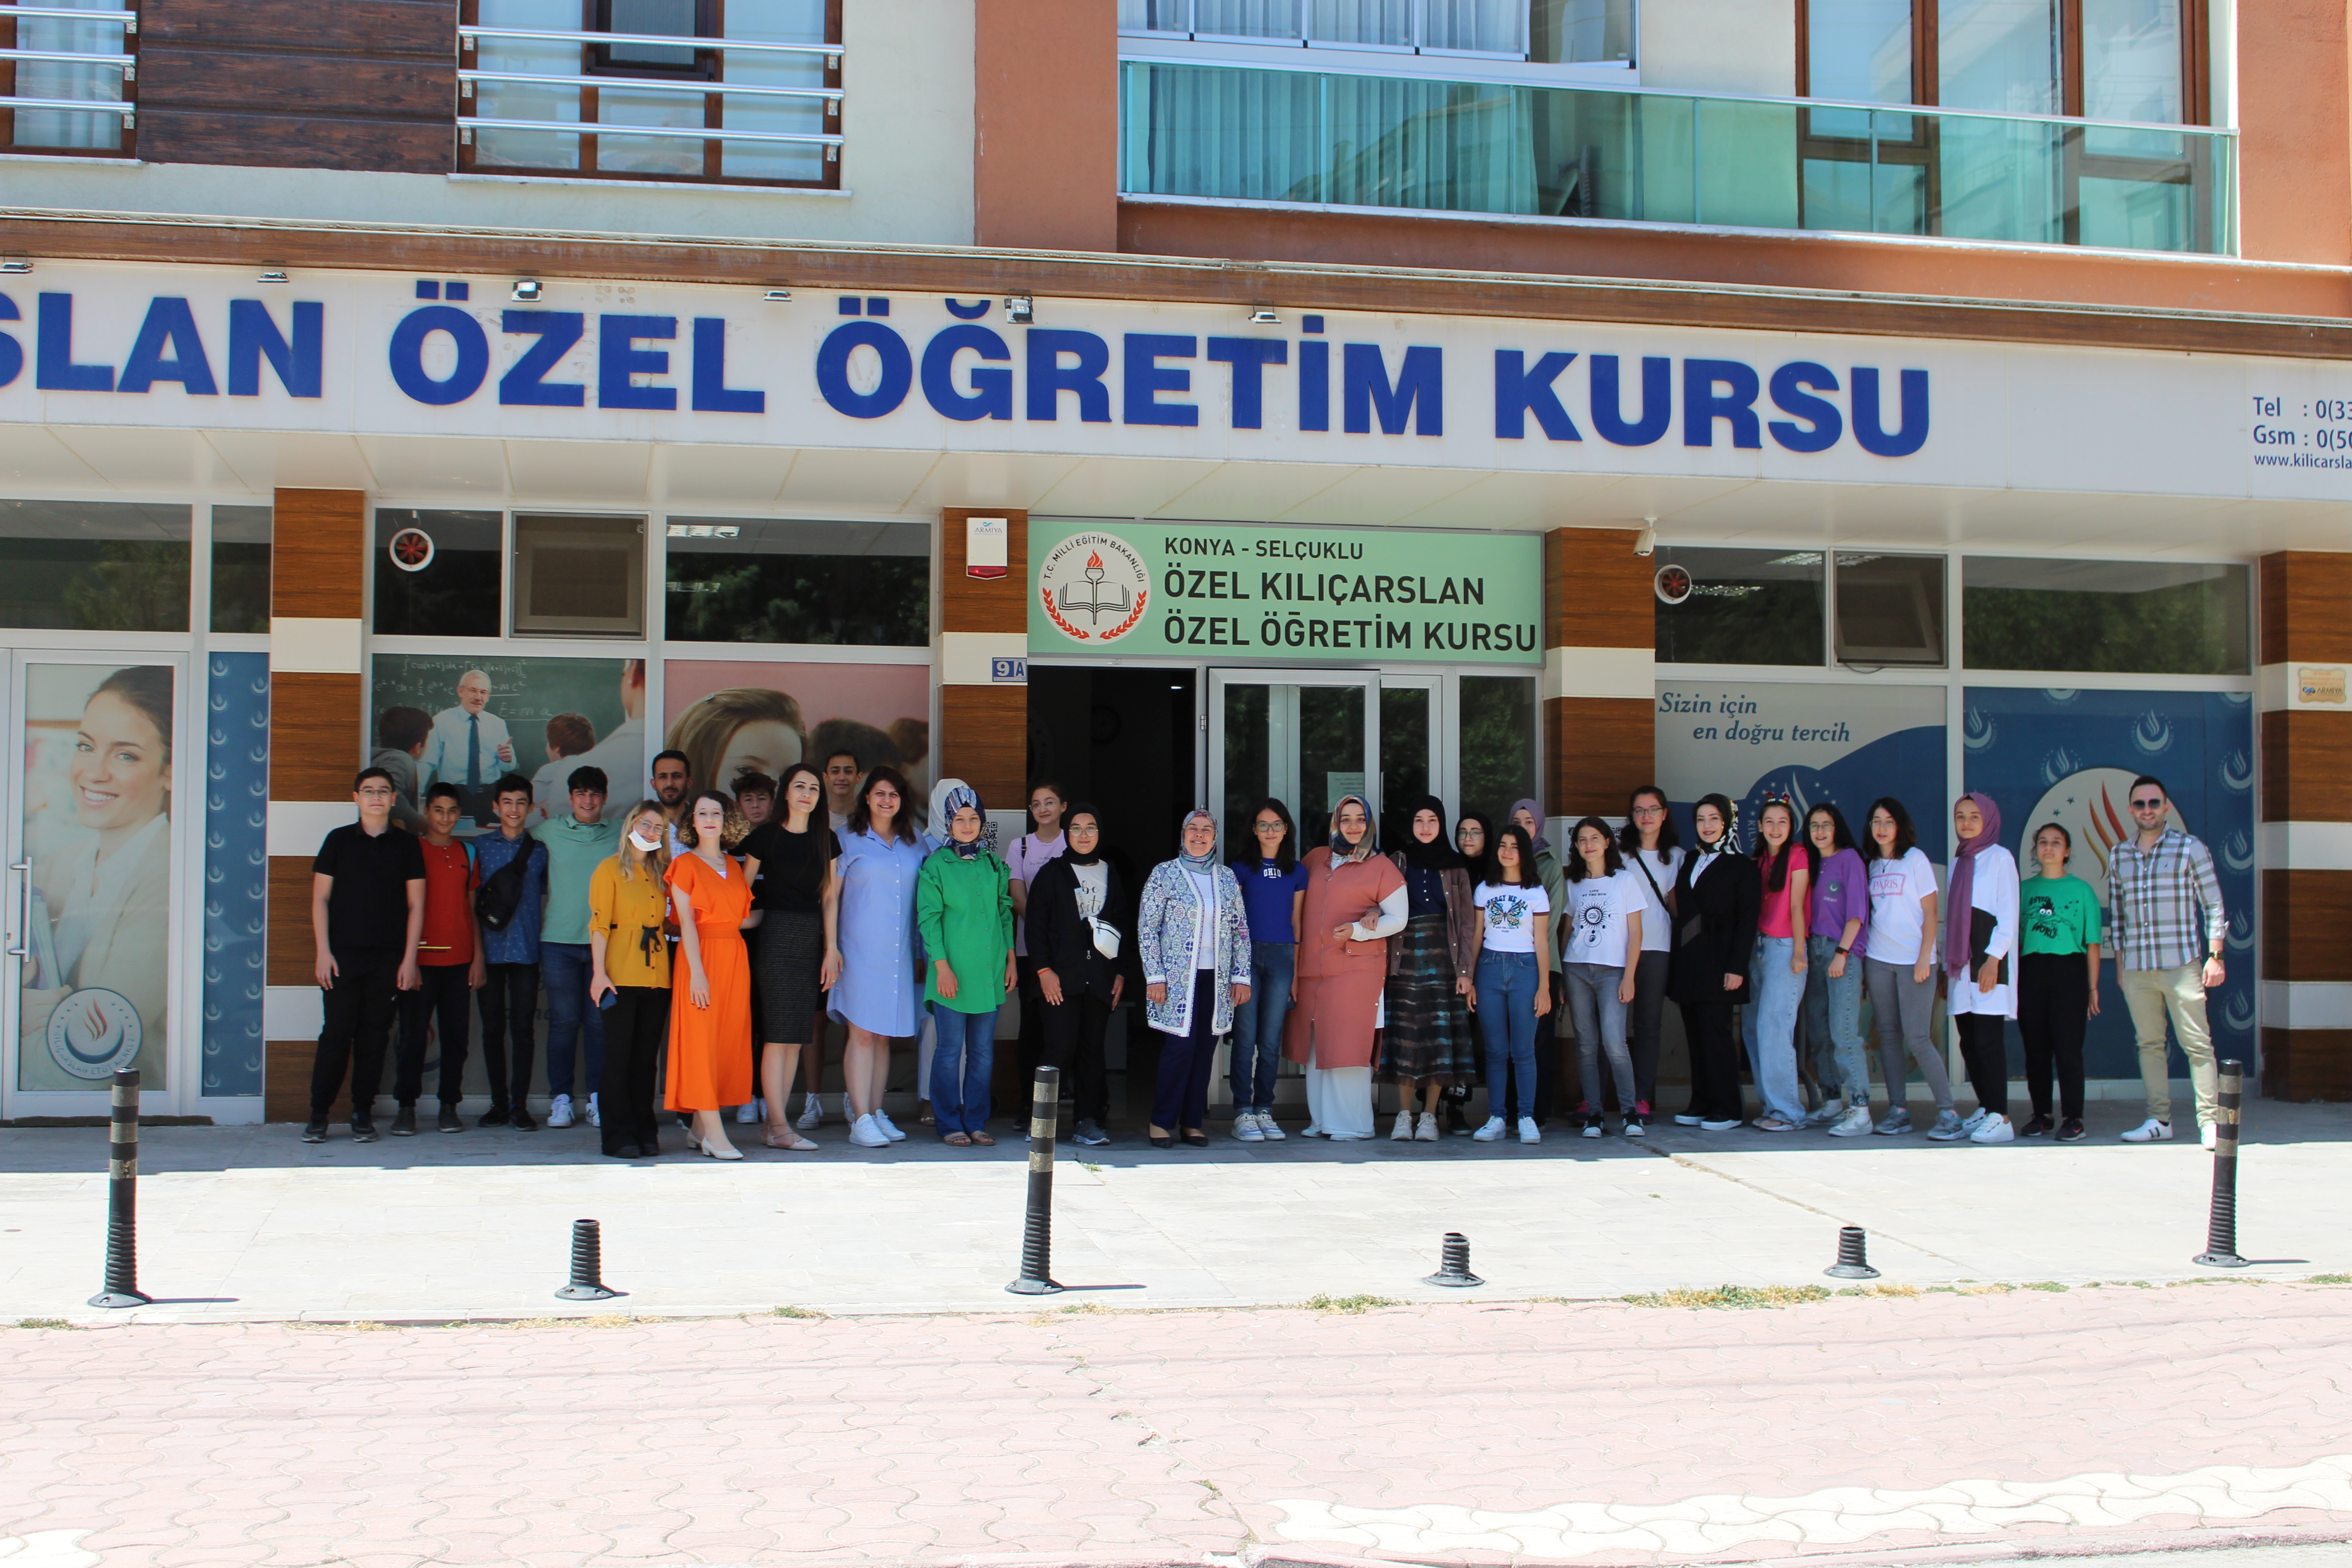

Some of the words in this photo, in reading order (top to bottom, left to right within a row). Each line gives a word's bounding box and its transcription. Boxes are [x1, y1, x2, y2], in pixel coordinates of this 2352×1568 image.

[388, 280, 765, 413] ÖZEL
[816, 297, 1443, 436] ÖĞRETİM
[1495, 348, 1931, 456] KURSU
[2253, 397, 2281, 416] Tel
[2253, 425, 2295, 445] Gsm
[1052, 540, 1075, 563] MİLLİ
[1075, 535, 1107, 547] EĞİTİM
[1110, 541, 1145, 582] BAKANLIĞI
[1165, 537, 1235, 556] KONYA
[1255, 540, 1362, 561] SELÇUKLU
[1165, 562, 1250, 599] ÖZEL
[1262, 572, 1484, 607] KILIÇARSLAN
[1165, 608, 1250, 646] ÖZEL
[1261, 611, 1411, 649] ÖĞRETİM
[1425, 622, 1536, 652] KURSU
[1659, 692, 1711, 714] Sizin
[1720, 694, 1757, 718] için
[1693, 727, 1717, 740] en
[1725, 720, 1784, 745] doğru
[1792, 722, 1850, 742] tercih
[1082, 880, 1099, 894] be
[1873, 878, 1898, 890] PARIS
